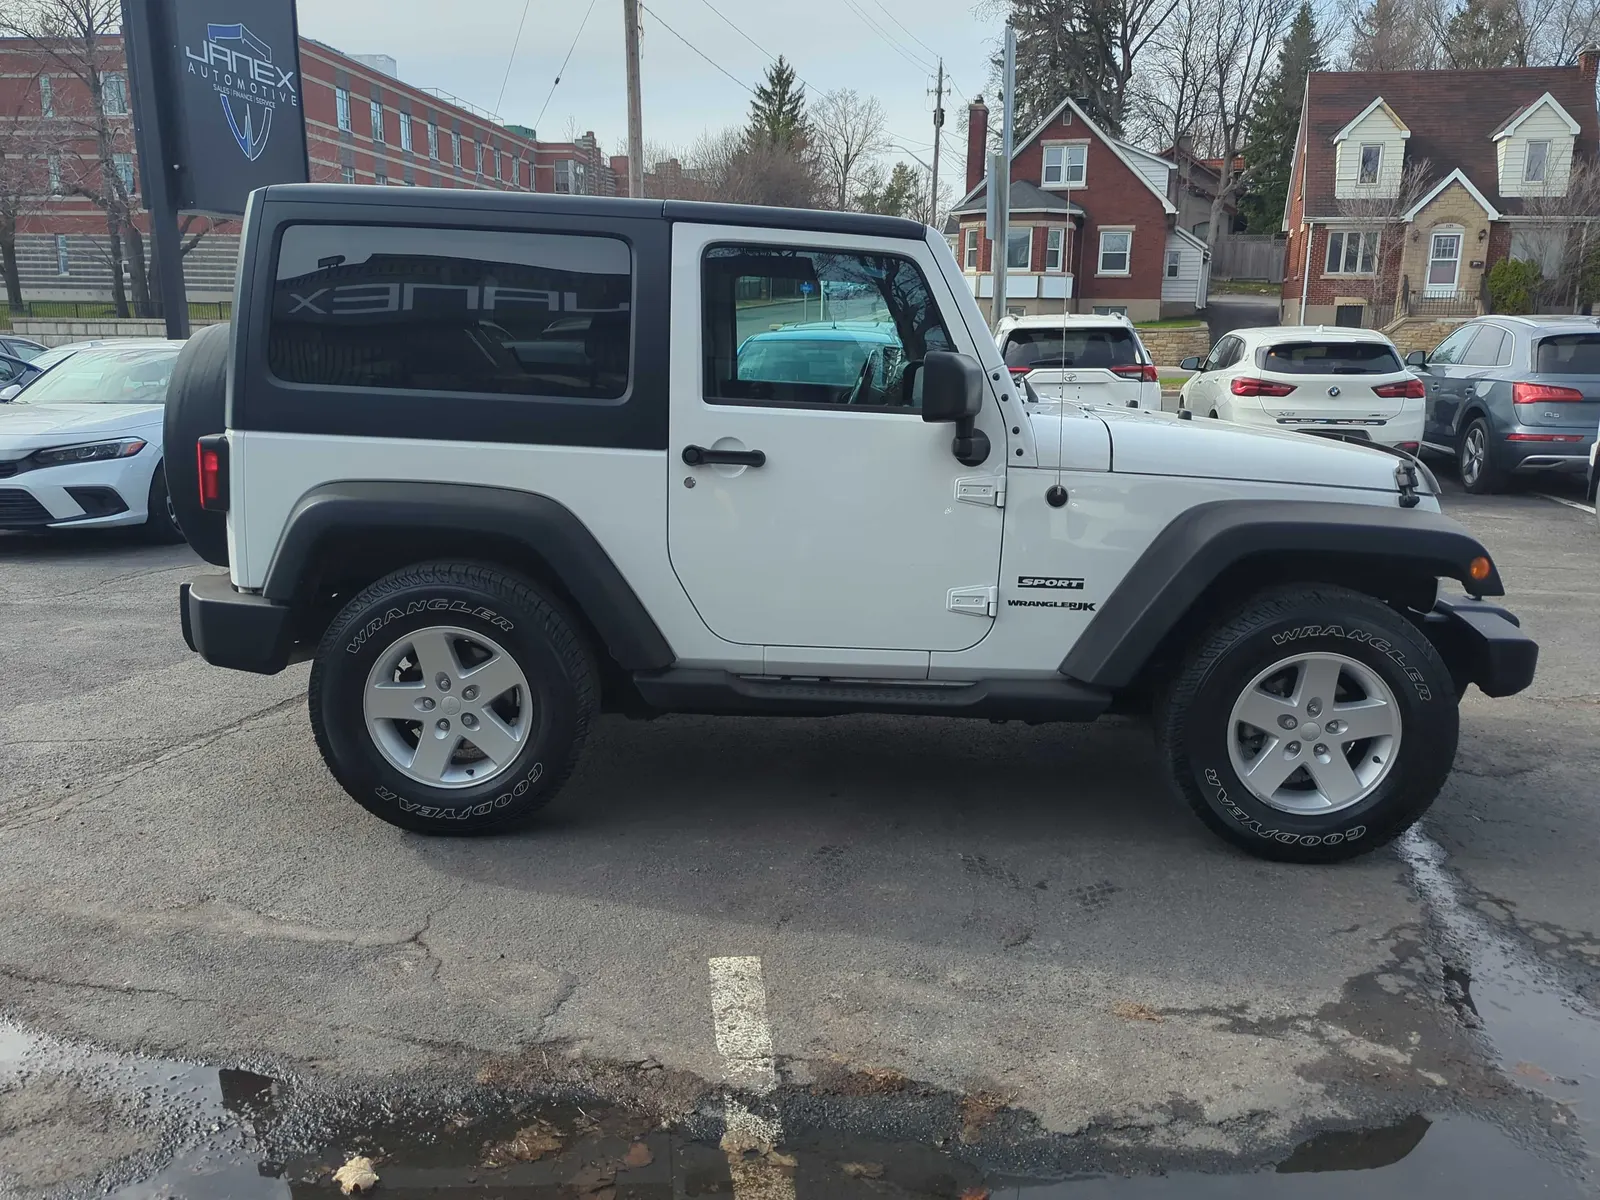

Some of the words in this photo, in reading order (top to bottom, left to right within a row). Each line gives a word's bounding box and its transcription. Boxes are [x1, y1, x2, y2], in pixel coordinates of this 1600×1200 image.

[185, 40, 295, 92] JANEX
[188, 62, 297, 106] AUTOMOTIVE
[213, 84, 230, 95] SALES
[233, 90, 253, 102] FINANCE
[256, 97, 276, 109] SERVICE
[1019, 577, 1084, 589] SPORT
[347, 598, 514, 654] WRANGLER
[1271, 625, 1432, 701] WRANGLER
[375, 762, 543, 820] GOODYEAR
[1204, 768, 1367, 846] GOODYEAR
